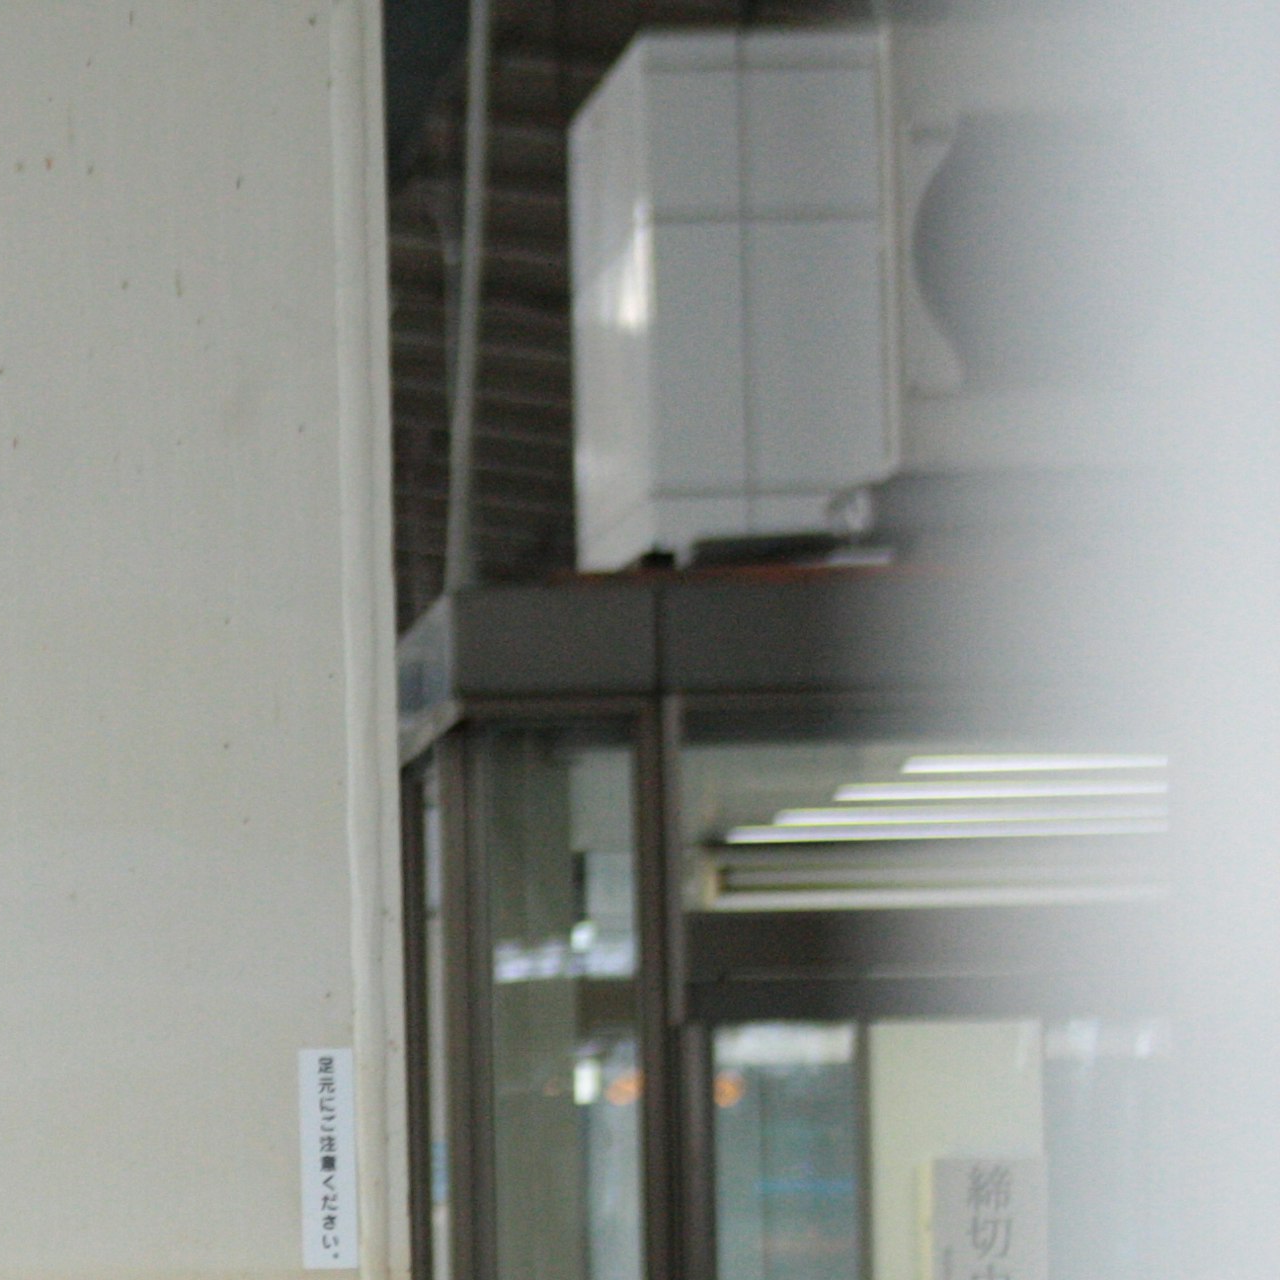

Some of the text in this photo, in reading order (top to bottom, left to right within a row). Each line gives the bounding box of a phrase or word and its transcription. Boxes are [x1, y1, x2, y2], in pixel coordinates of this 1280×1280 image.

[318, 1057, 340, 1259] 足元にご注意ください。
